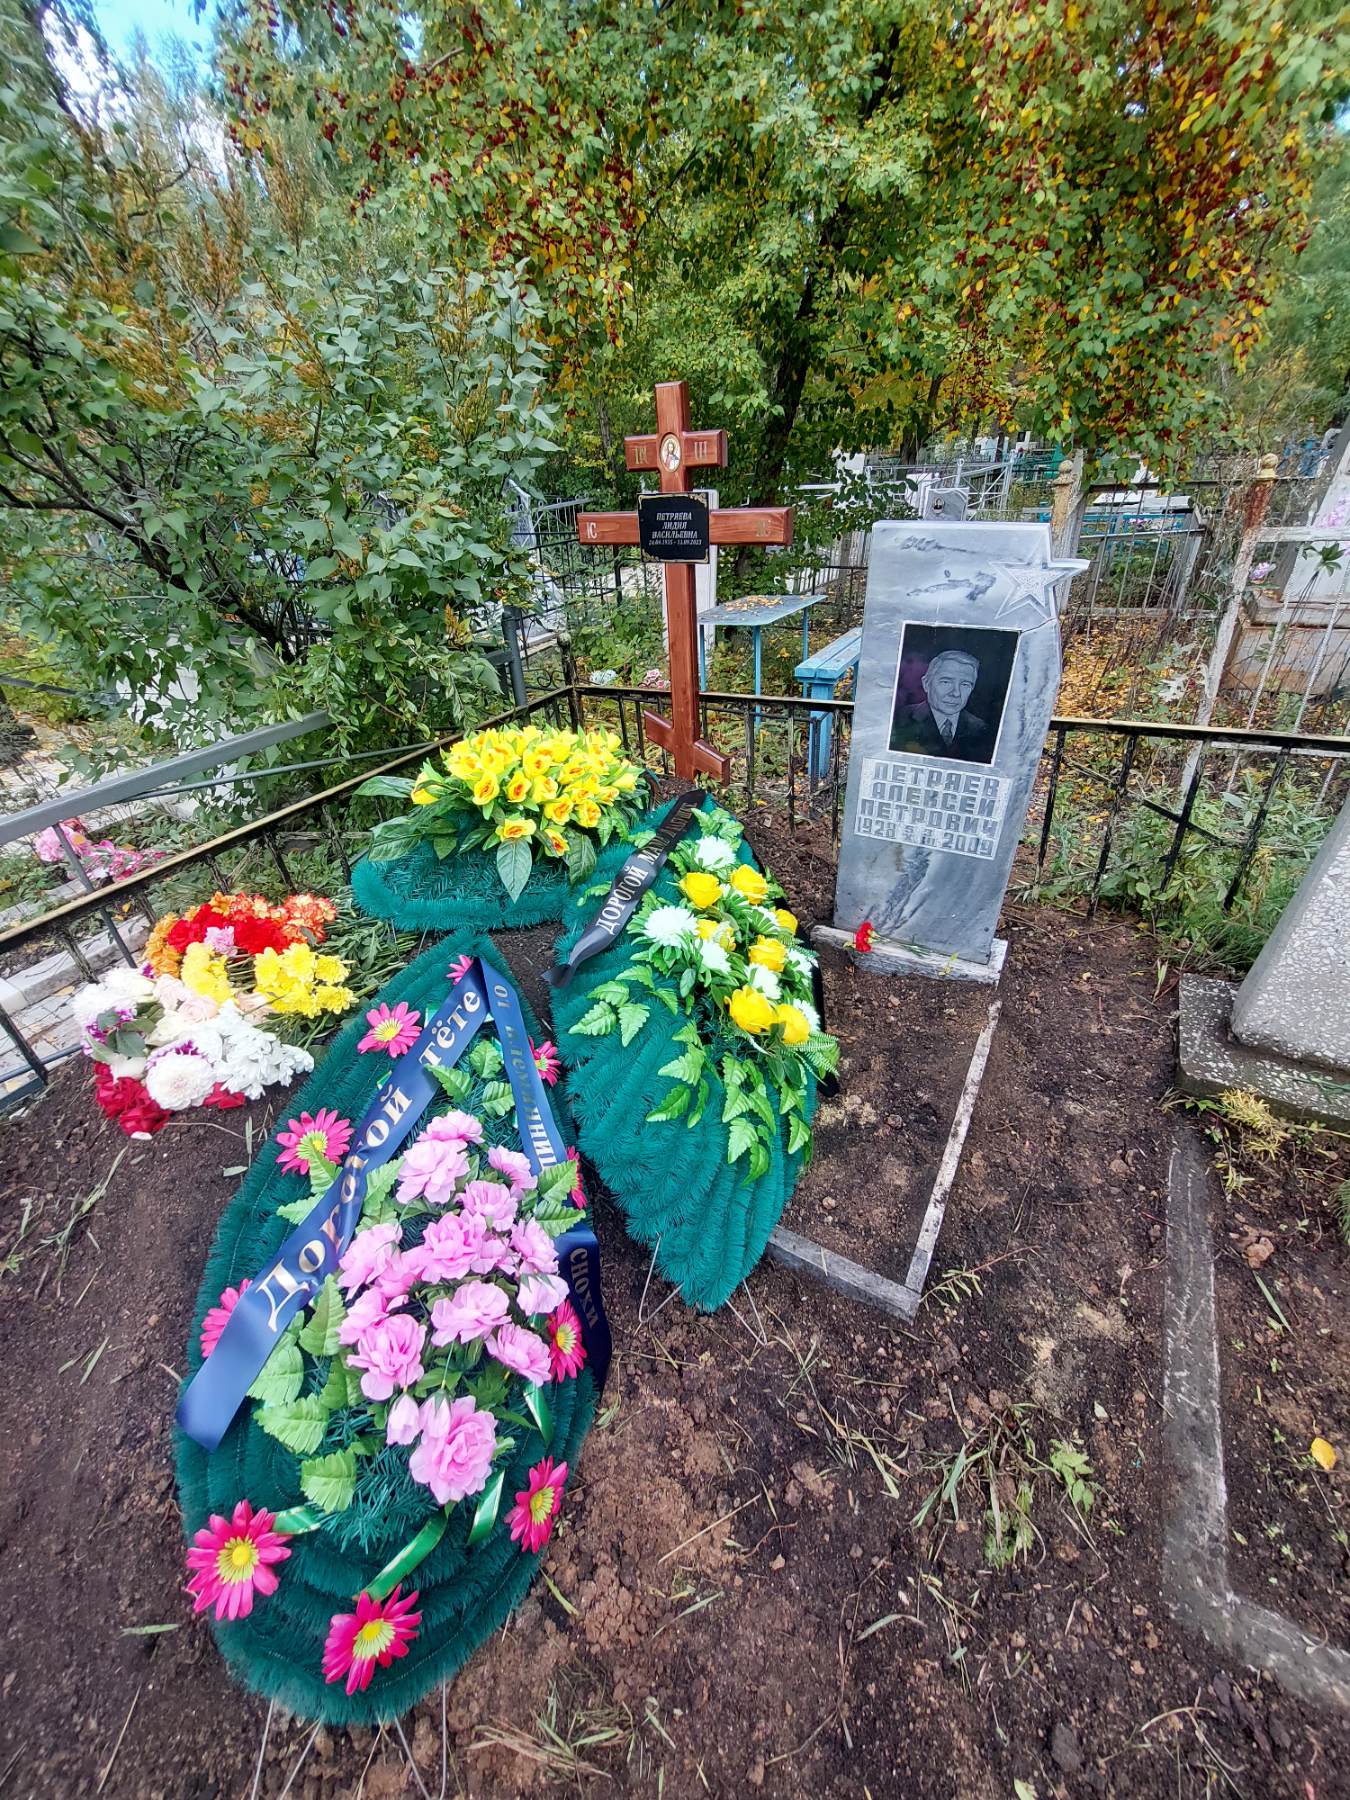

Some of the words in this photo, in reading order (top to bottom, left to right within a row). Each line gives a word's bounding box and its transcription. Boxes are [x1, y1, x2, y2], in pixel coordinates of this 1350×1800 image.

[873, 761, 1000, 798] ПЕТРЯЕВ
[860, 798, 998, 838] ПЕТРОВИЧ
[941, 831, 994, 857] 2009
[595, 865, 649, 936] ДОРОГОЙ
[419, 990, 481, 1068] тёте
